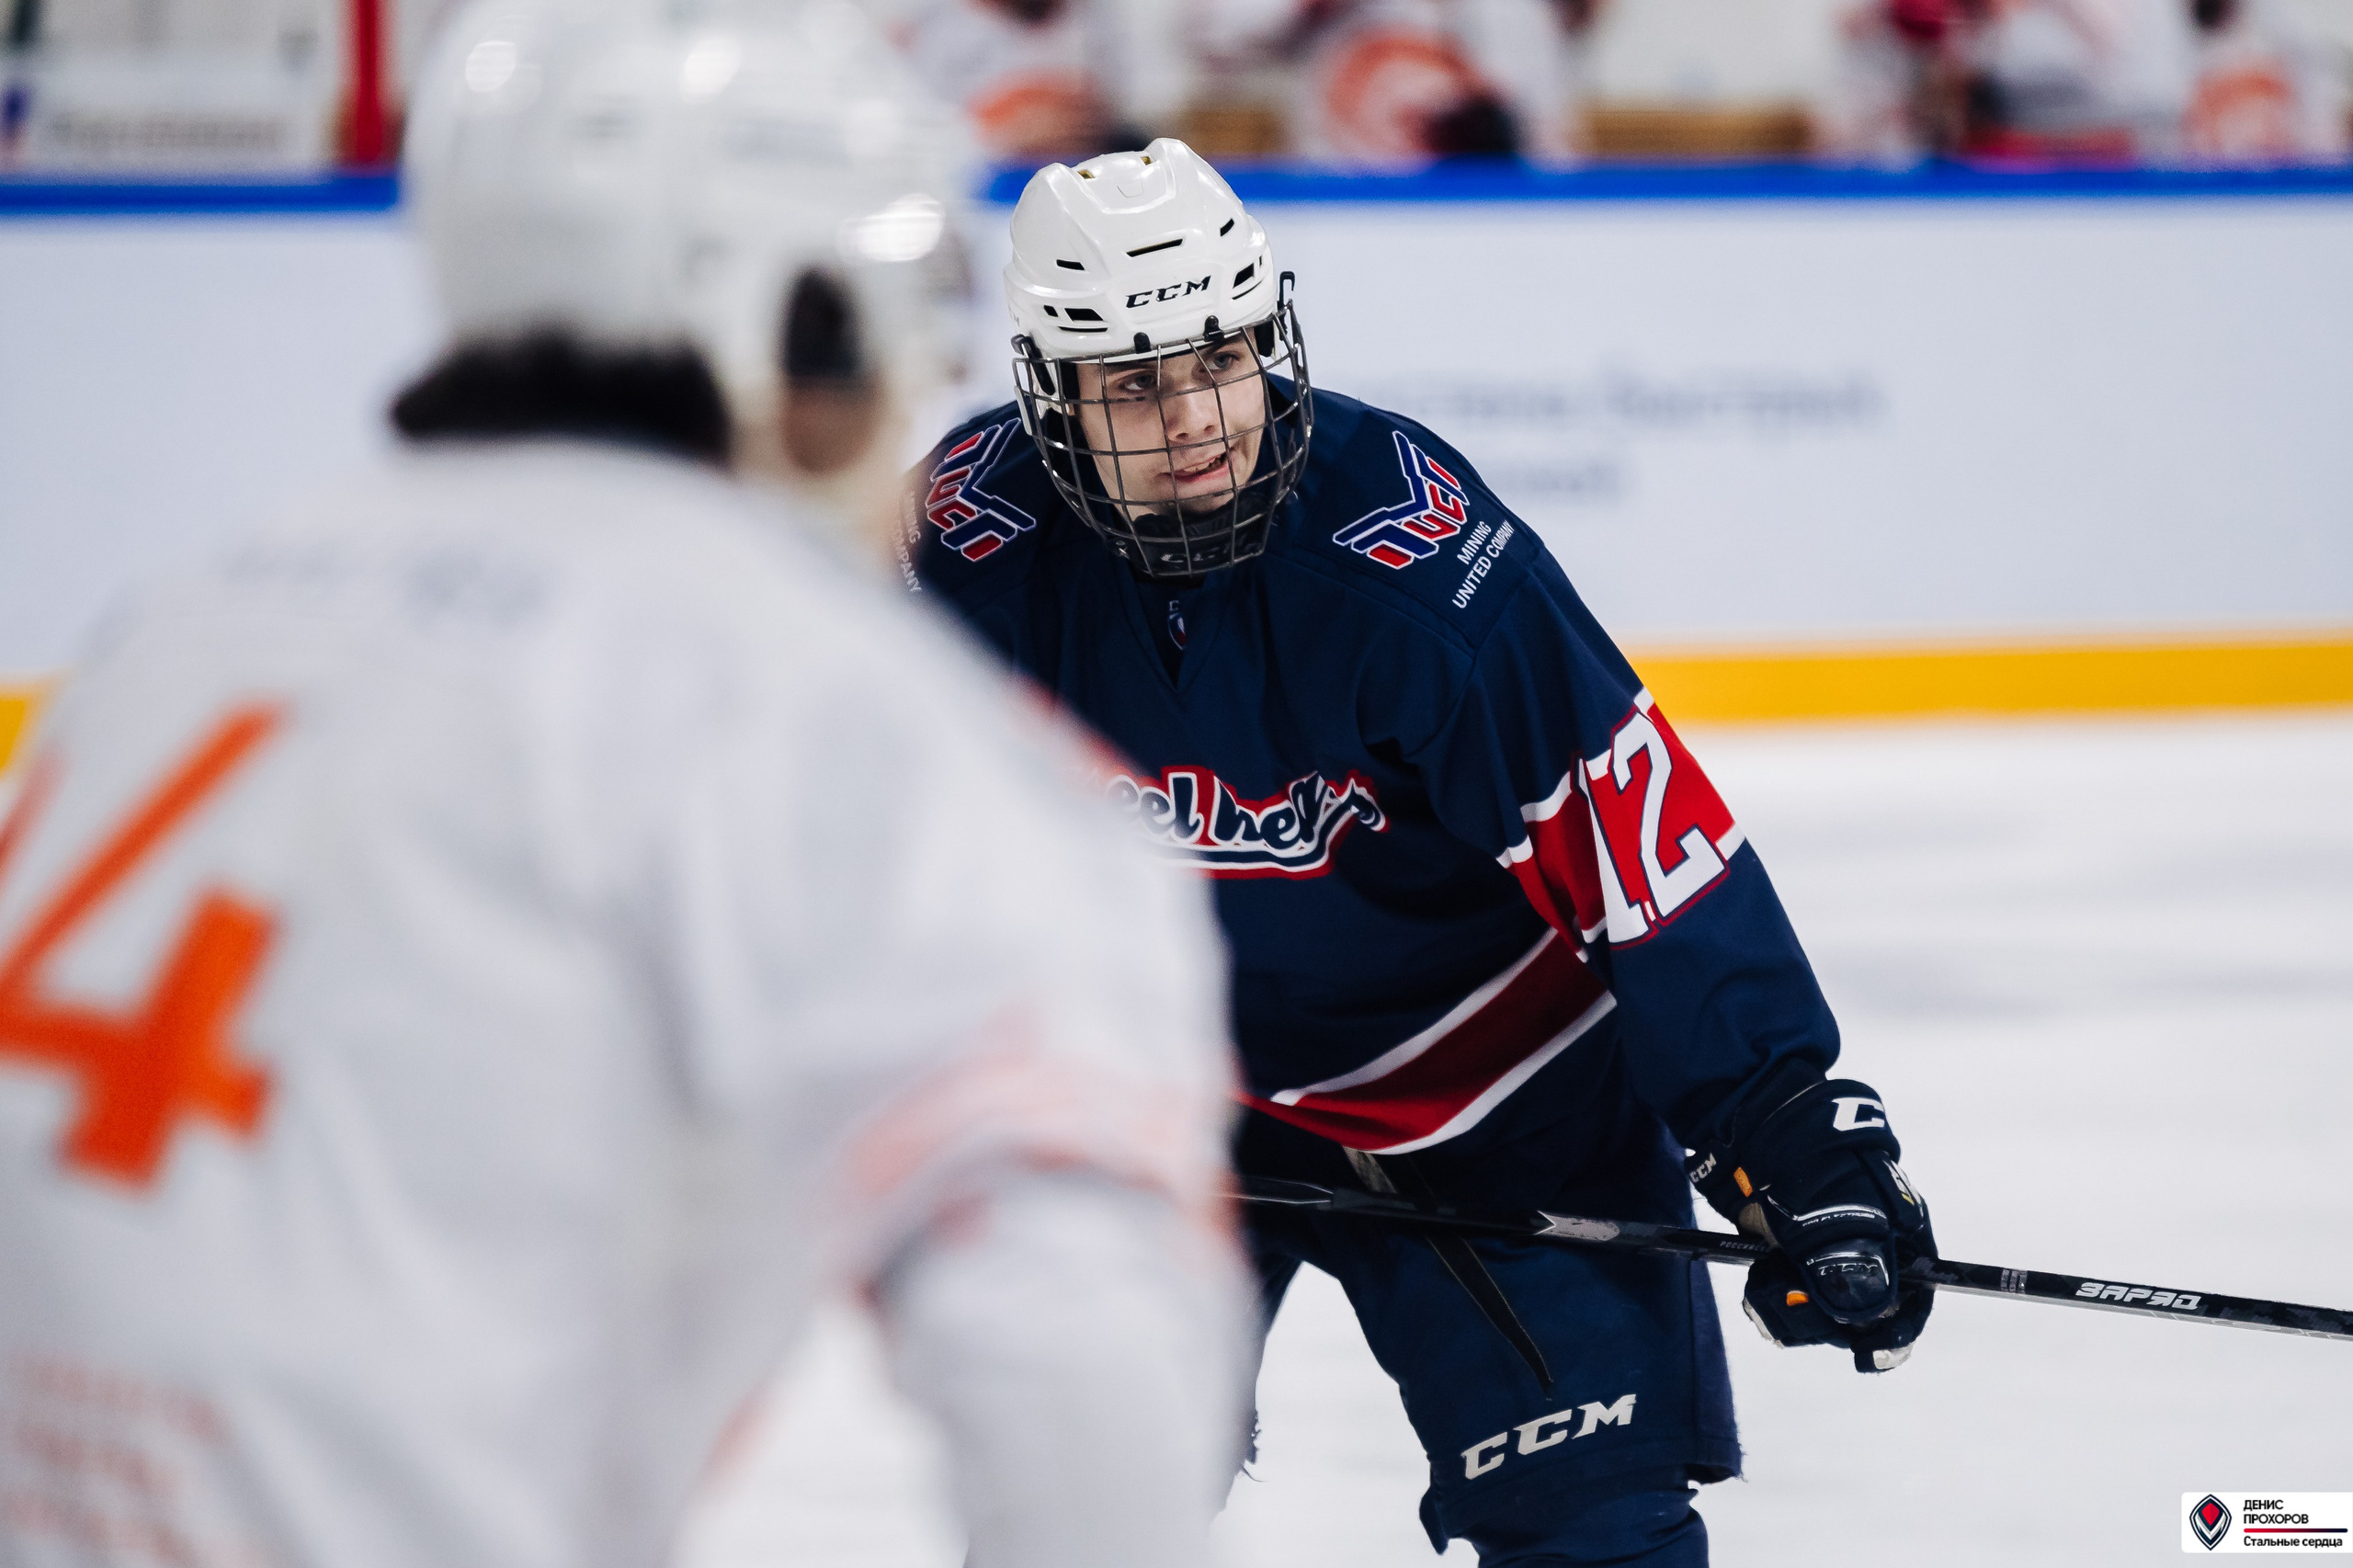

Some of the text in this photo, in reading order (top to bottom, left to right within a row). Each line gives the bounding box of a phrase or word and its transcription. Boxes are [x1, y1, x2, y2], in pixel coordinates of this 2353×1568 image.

[1126, 276, 1211, 308] CCM
[1452, 519, 1515, 608] UNITED COMPANY
[1457, 520, 1492, 565] MINING
[1575, 709, 1728, 946] 12
[1690, 1153, 1717, 1184] CCM
[1461, 1394, 1637, 1480] CCM
